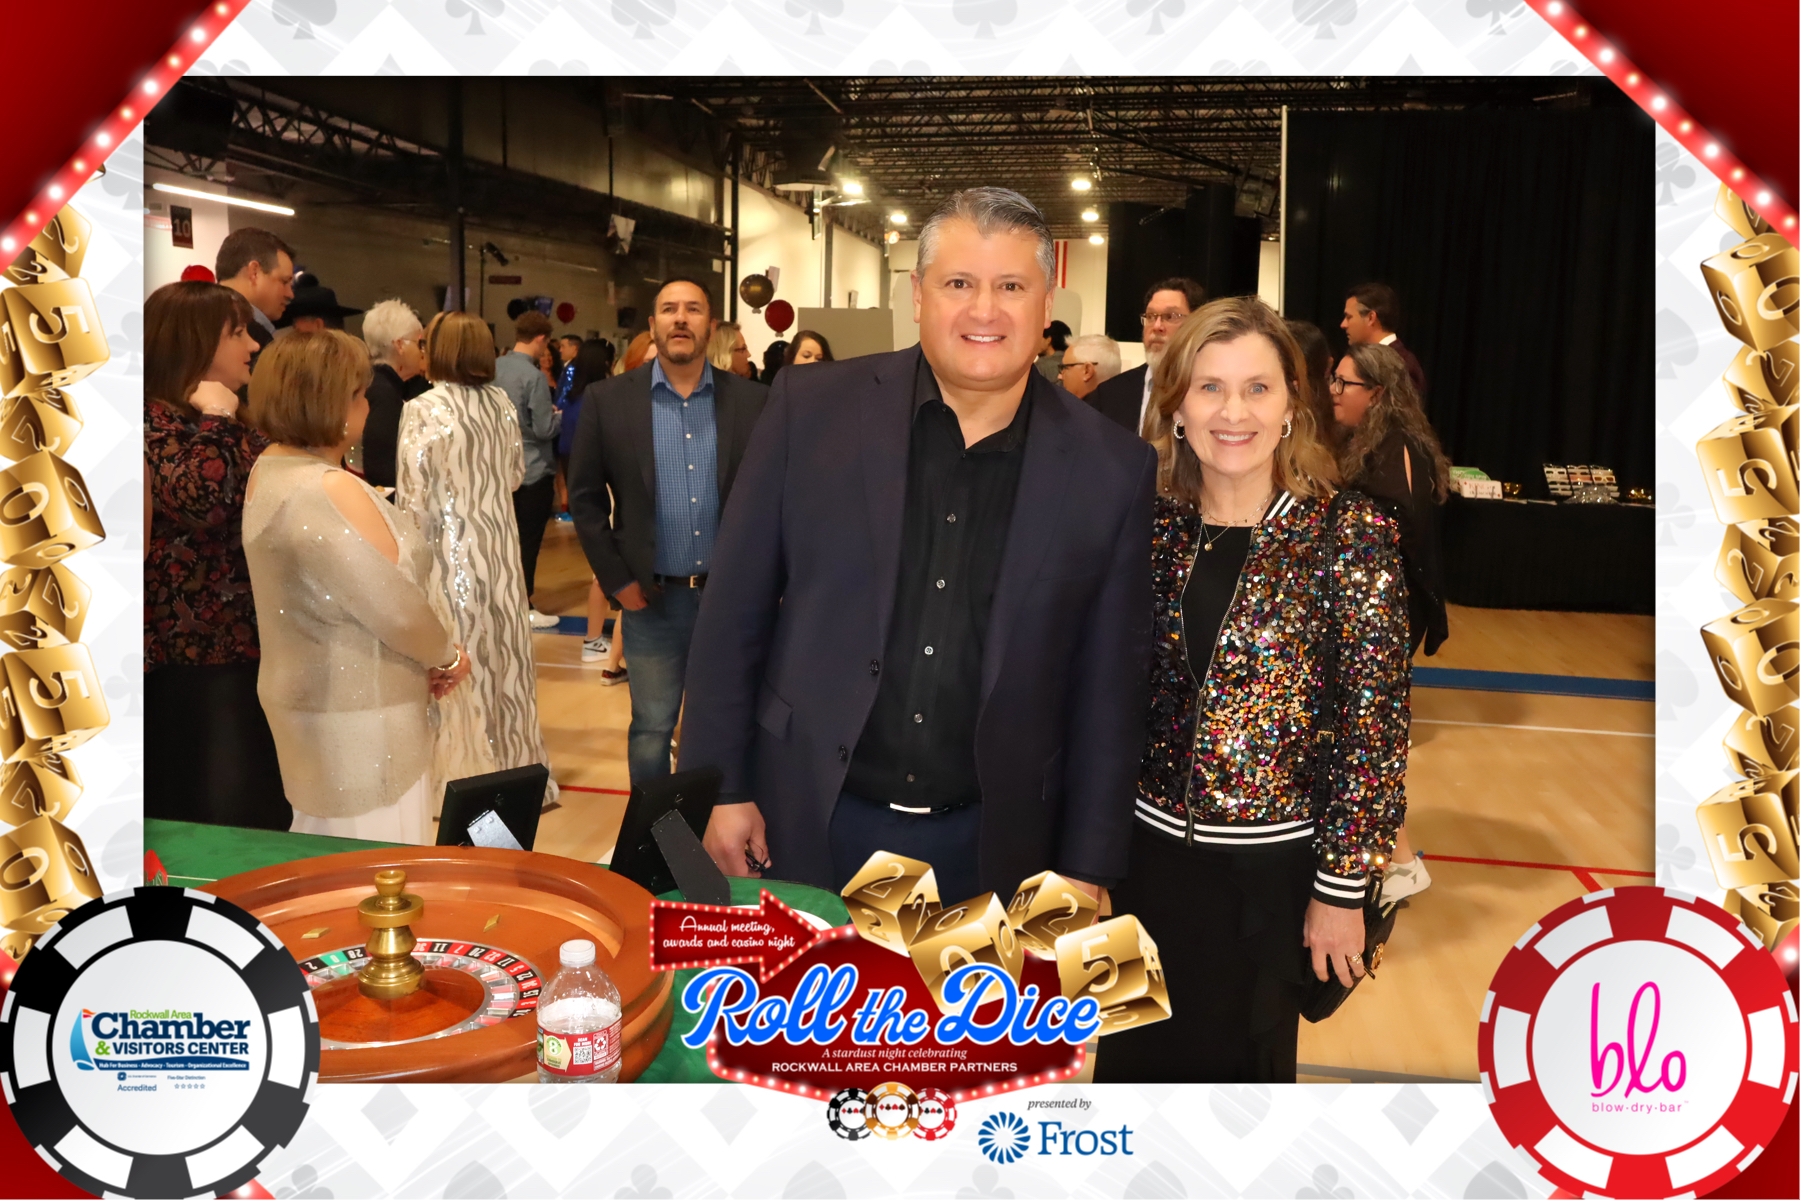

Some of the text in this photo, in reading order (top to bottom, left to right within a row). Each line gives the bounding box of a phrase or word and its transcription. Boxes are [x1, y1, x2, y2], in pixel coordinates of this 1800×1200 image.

[173, 218, 191, 238] 10
[433, 943, 448, 952] 11
[454, 945, 464, 954] 7
[468, 947, 486, 957] 20
[329, 954, 340, 963] 0
[347, 948, 363, 959] 28
[484, 951, 501, 962] 32
[304, 962, 318, 970] 2
[497, 957, 515, 967] 17
